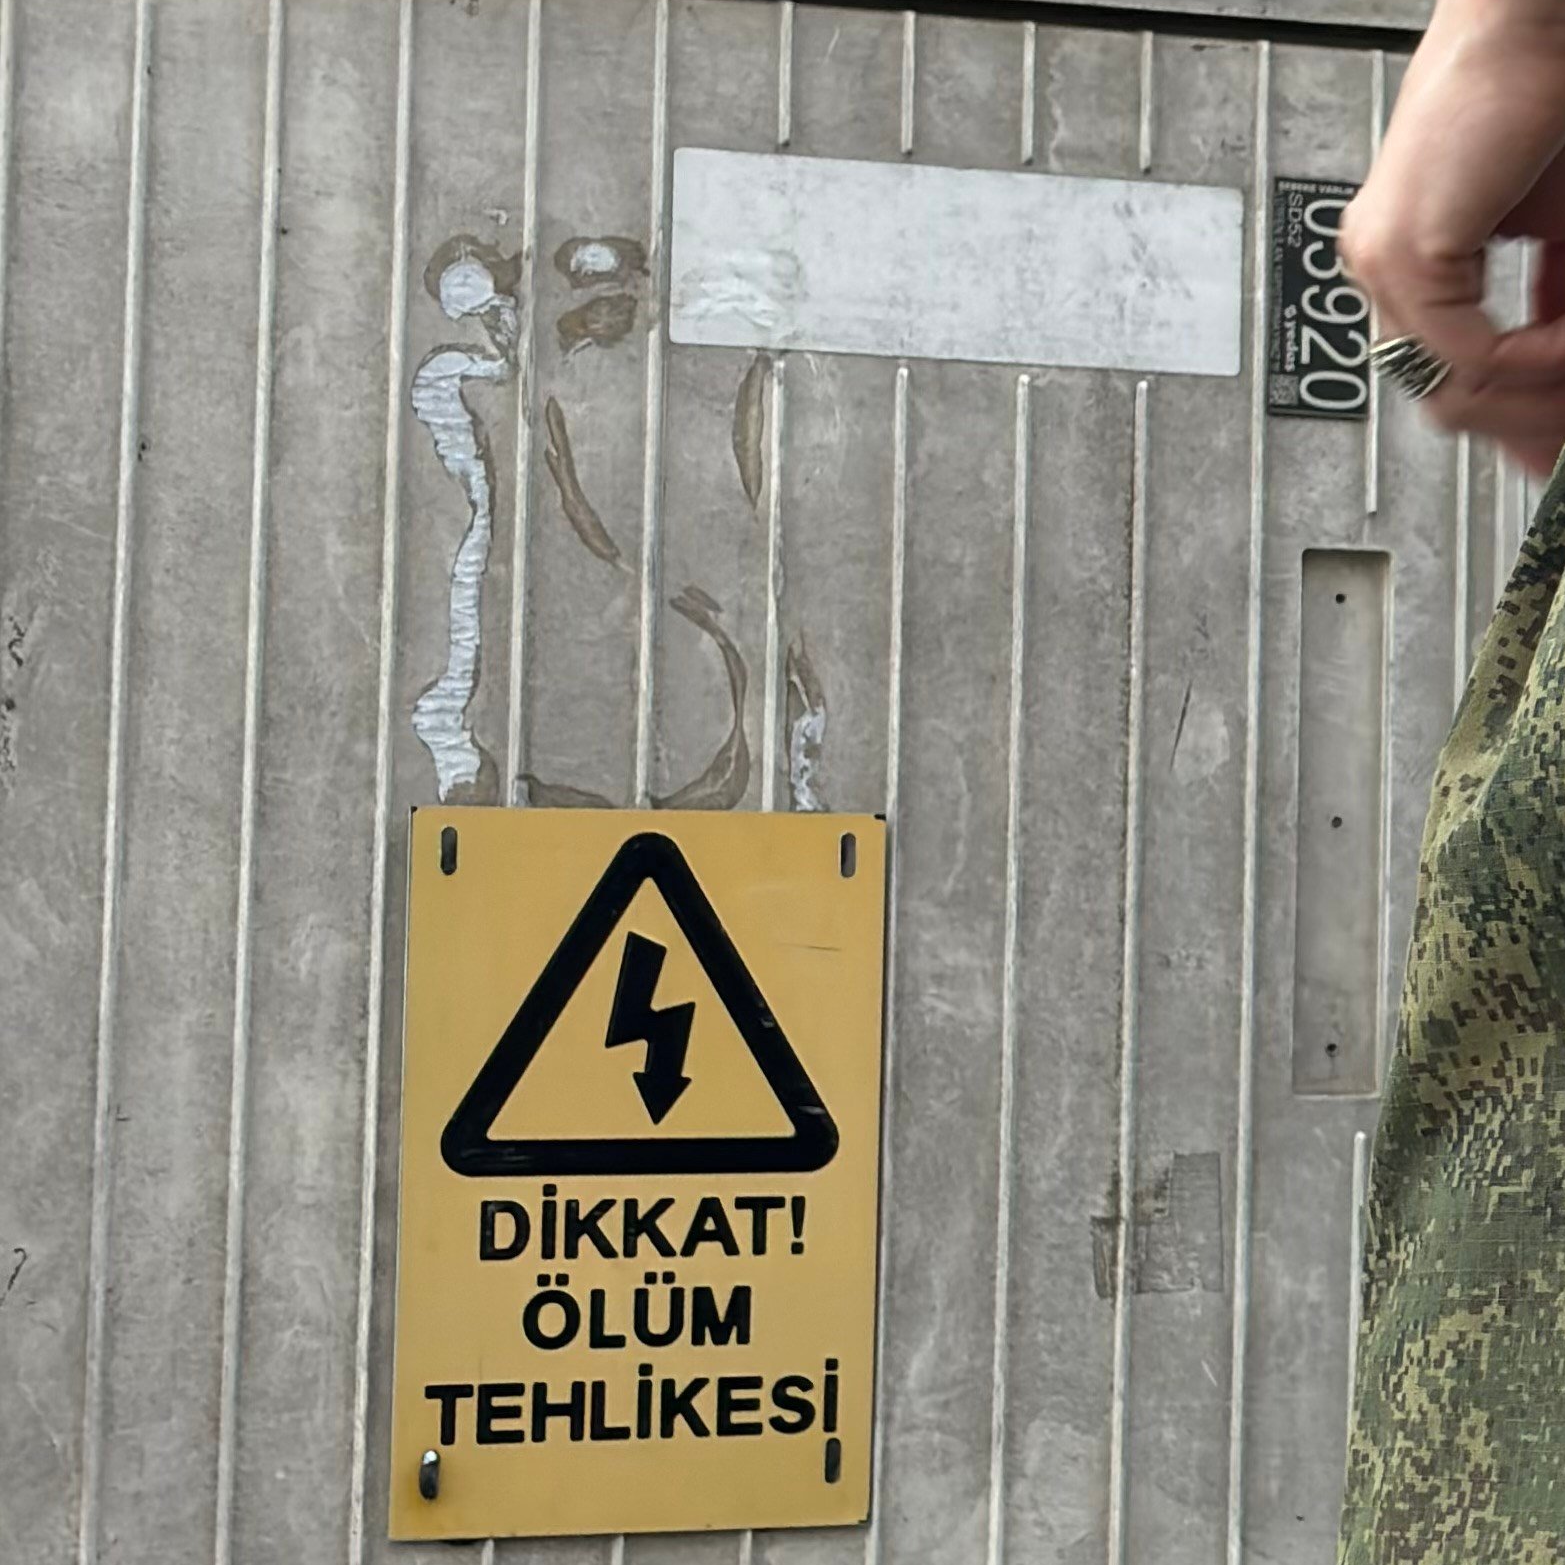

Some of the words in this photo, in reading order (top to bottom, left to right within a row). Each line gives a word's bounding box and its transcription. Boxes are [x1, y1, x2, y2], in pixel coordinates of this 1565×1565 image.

[1287, 193, 1304, 249] SD52
[478, 1184, 807, 1261] DİKKAT!
[521, 1271, 753, 1351] ÖLÜM
[424, 1357, 839, 1447] TEHLİKESİ
